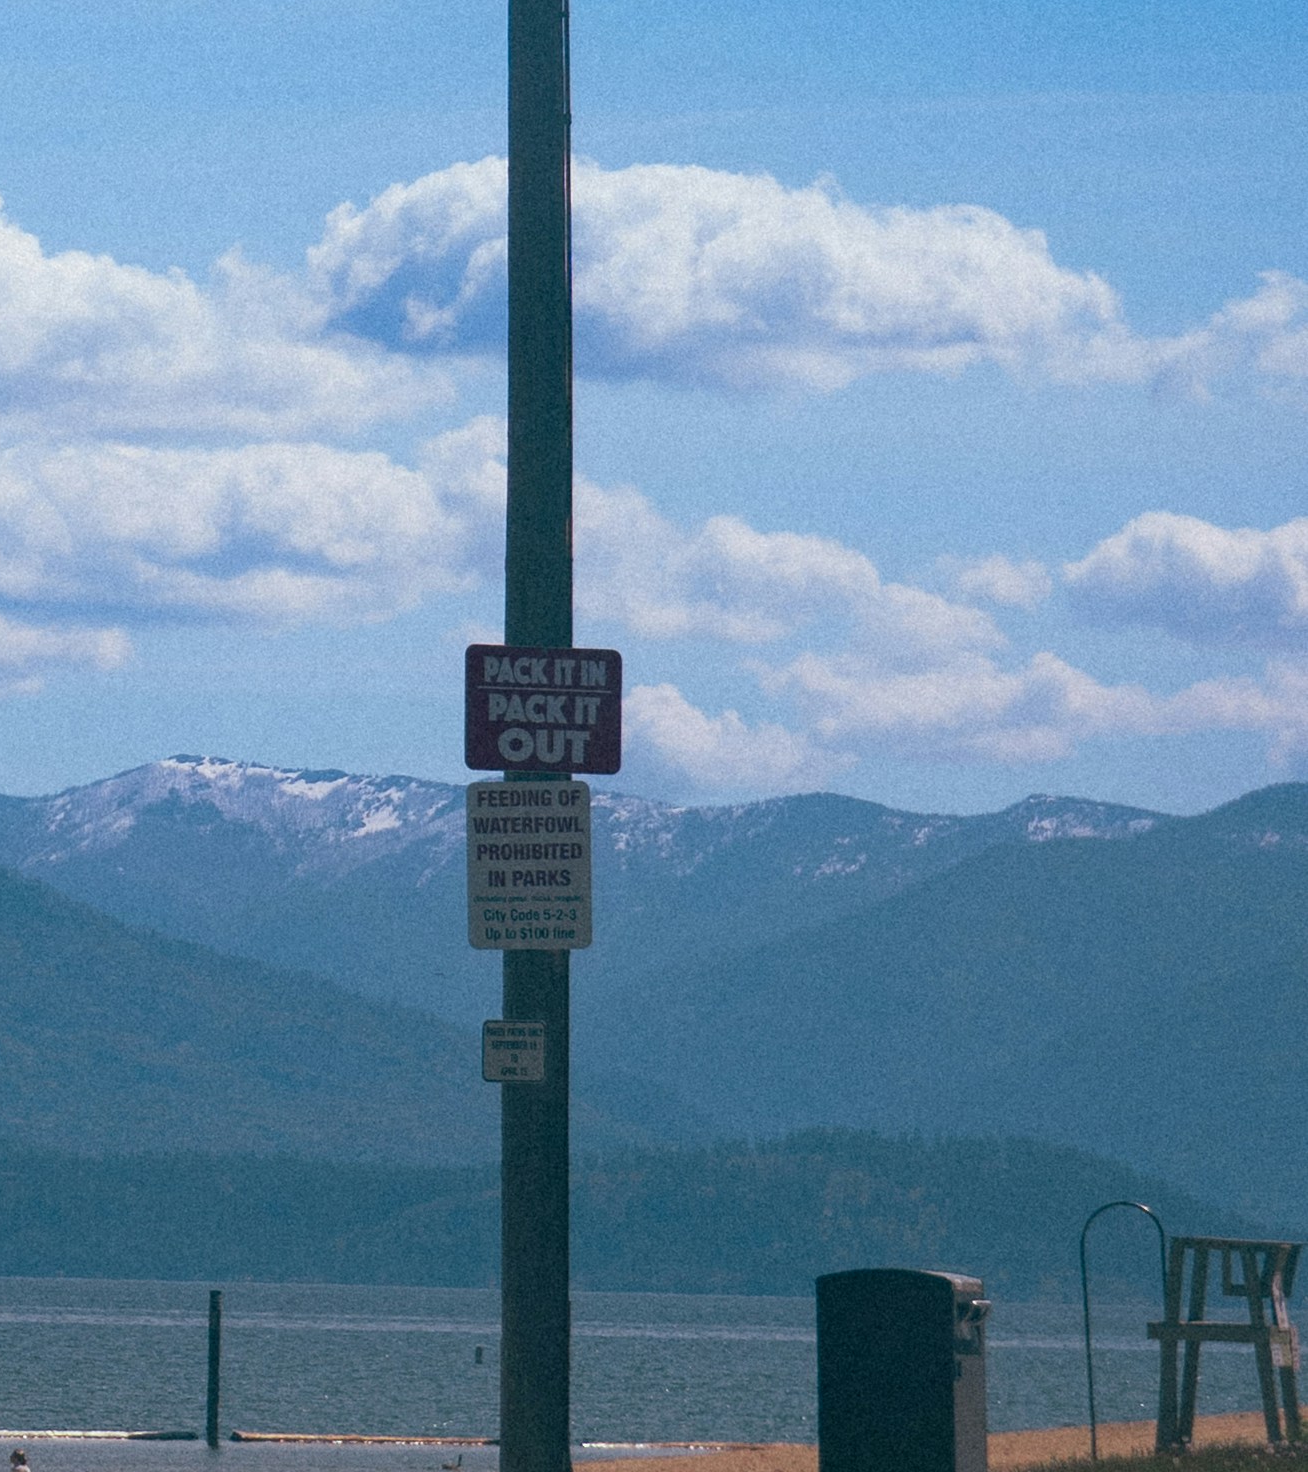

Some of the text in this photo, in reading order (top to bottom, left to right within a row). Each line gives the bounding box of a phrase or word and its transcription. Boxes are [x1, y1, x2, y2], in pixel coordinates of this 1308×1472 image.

[484, 656, 607, 686] PACK IT IN
[488, 693, 601, 724] PACK IT
[497, 727, 590, 764] OUT
[477, 789, 581, 807] FEEDING OF
[473, 816, 583, 834] WATERFOWL
[477, 843, 582, 861] PROHIBITED
[488, 870, 571, 887] IN PARKS
[484, 909, 577, 922] City Code 5-2-3
[485, 927, 575, 942] Up to $100 fine
[491, 1040, 528, 1050] SEPTEMBER
